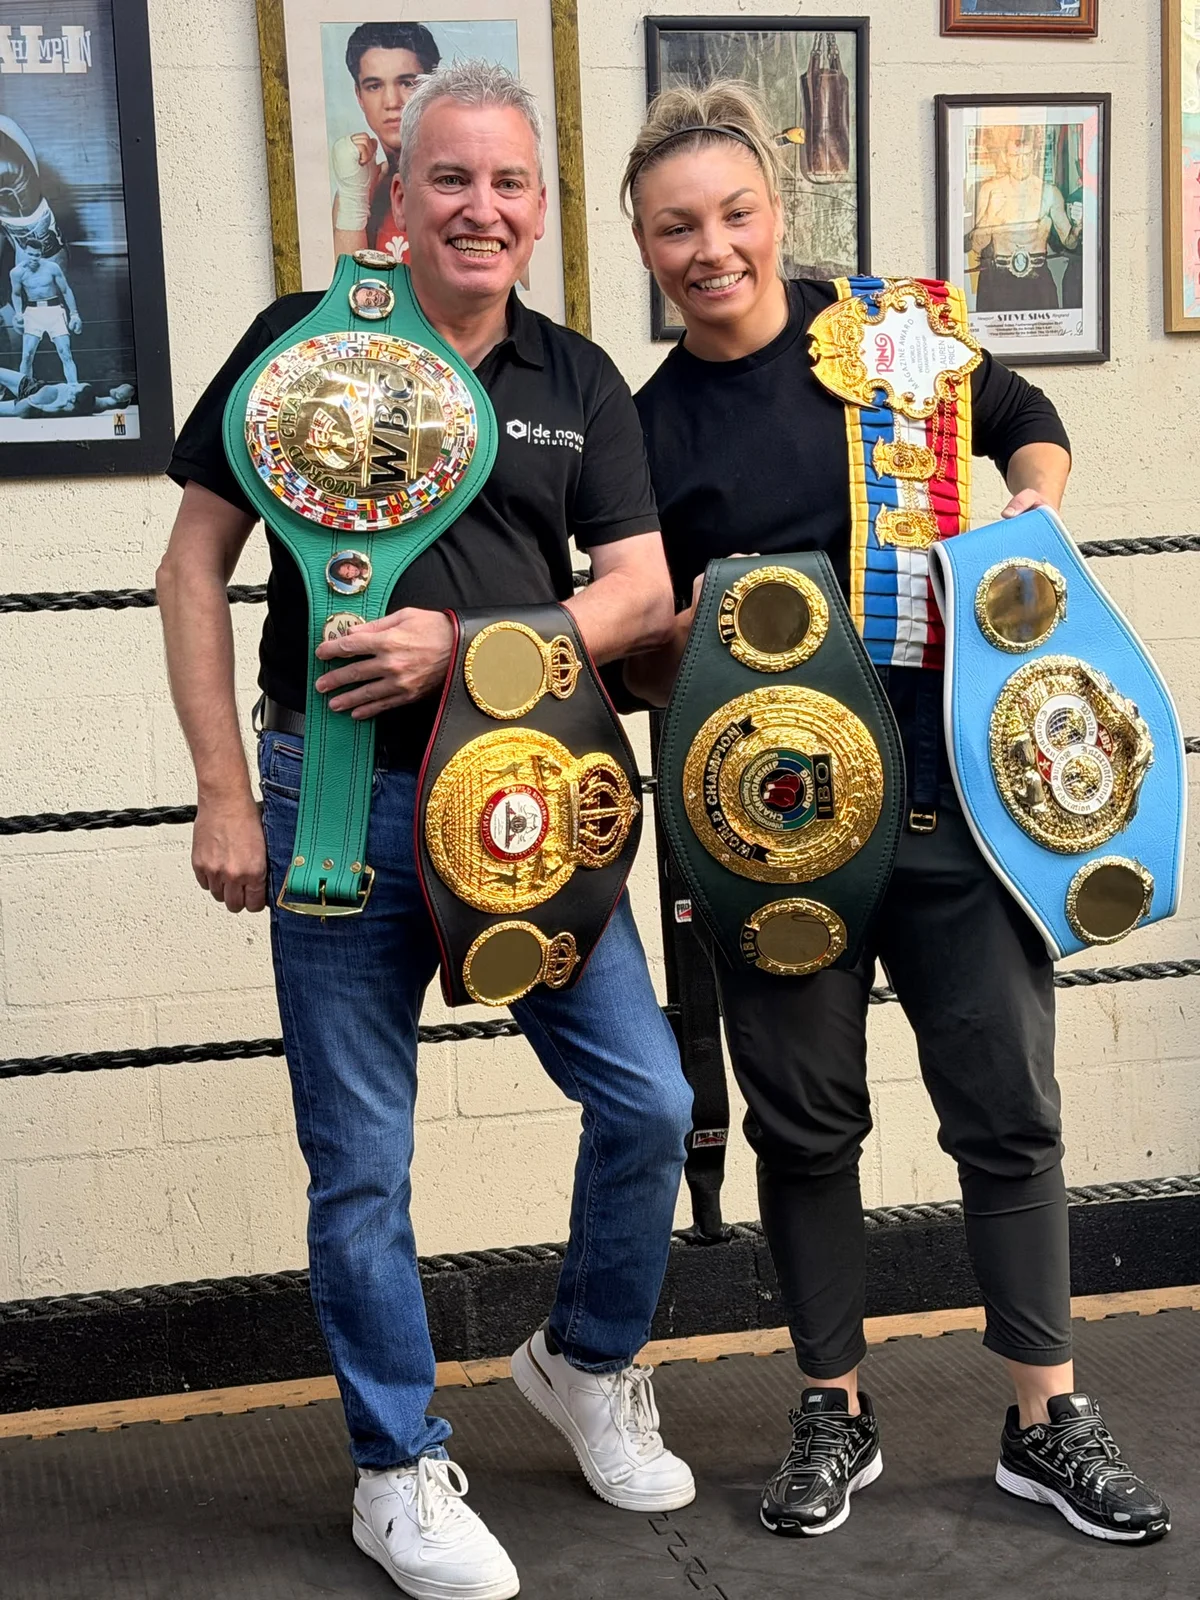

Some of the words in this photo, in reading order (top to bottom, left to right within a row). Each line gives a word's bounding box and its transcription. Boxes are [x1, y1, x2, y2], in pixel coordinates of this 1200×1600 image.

[898, 318, 914, 346] AWARD
[997, 313, 1025, 322] STEVE
[1028, 312, 1051, 320] SIMS
[898, 348, 919, 390] MAGAZINE
[938, 340, 947, 369] LAUREN
[948, 344, 956, 365] PRICE
[369, 371, 414, 485] WBC
[532, 423, 551, 439] de
[555, 429, 584, 445] novo
[288, 445, 357, 497] WORLD
[721, 598, 736, 636] IBO
[1036, 710, 1056, 759] Champion
[1098, 728, 1112, 753] IBF
[705, 726, 740, 806] CHAMPION
[752, 760, 784, 821] CHAMPIONSHIP
[800, 769, 814, 809] BOXING
[815, 762, 832, 812] IBO
[710, 810, 751, 858] WORLD
[743, 930, 756, 958] IBO
